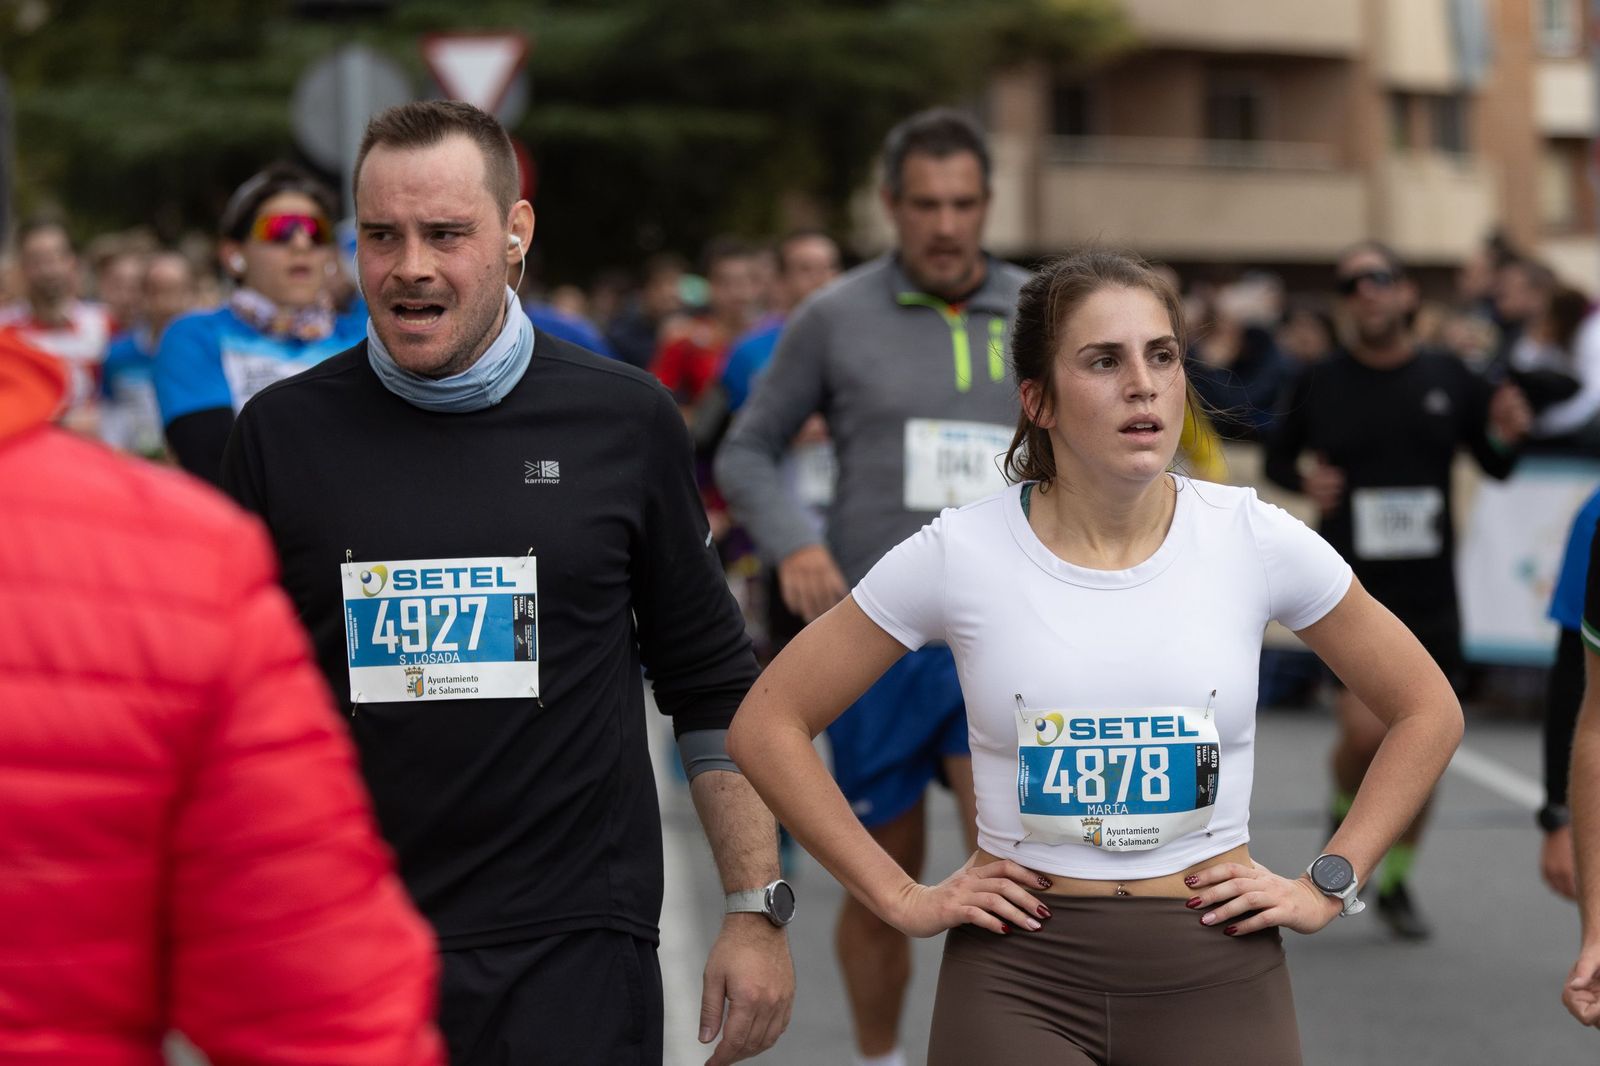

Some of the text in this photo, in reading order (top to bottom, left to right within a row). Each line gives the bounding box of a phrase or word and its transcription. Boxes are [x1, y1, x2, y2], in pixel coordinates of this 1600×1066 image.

[524, 477, 561, 485] karrimor
[392, 566, 517, 591] SETEL
[372, 596, 488, 654] 4927
[427, 675, 479, 686] Ayuntamiento
[438, 685, 479, 694] Salamanca
[1069, 715, 1199, 740] SETEL
[1042, 746, 1170, 804] 4878
[1087, 802, 1129, 815] MARÍA
[1106, 826, 1160, 837] Ayuntamiento
[1106, 837, 1159, 846] de Salamanca
